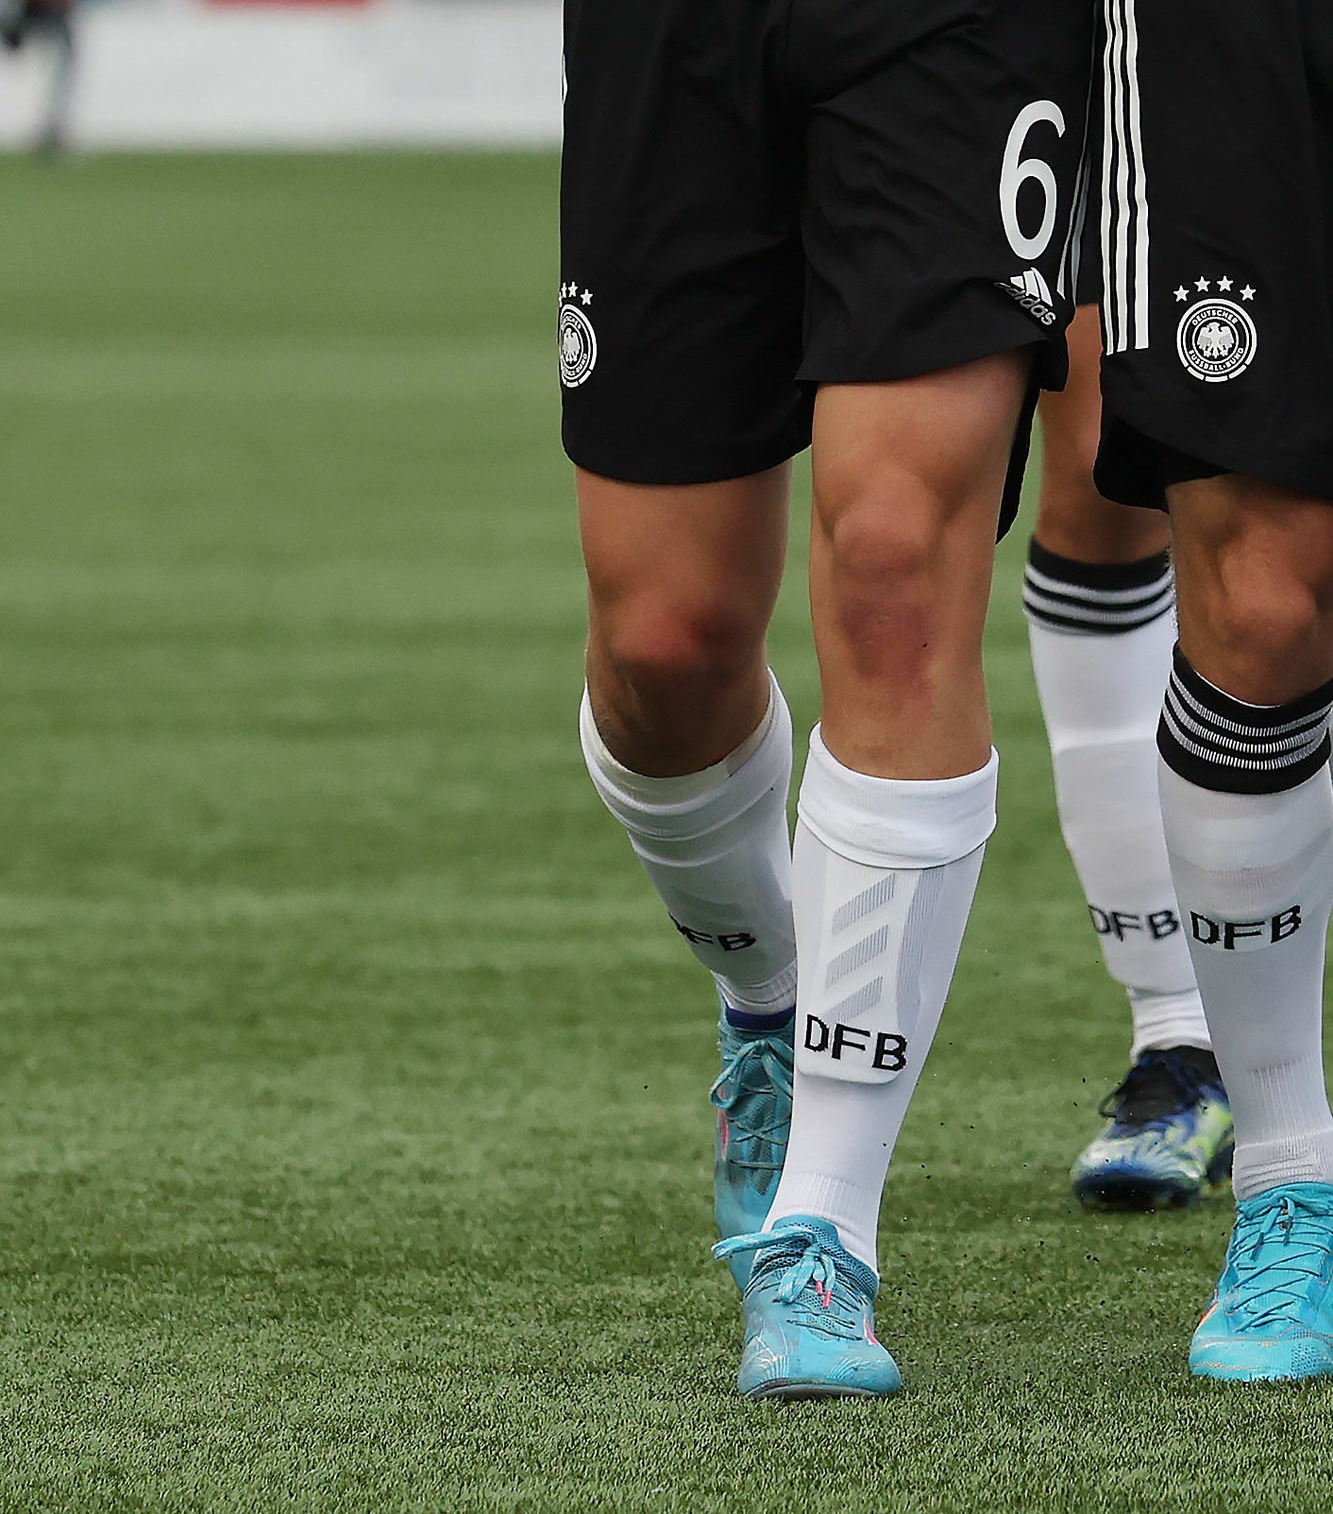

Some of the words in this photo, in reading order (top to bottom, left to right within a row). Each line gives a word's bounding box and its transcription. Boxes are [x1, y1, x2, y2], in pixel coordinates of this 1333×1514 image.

[1000, 99, 1065, 260] 6
[668, 911, 757, 952] FB
[1088, 904, 1178, 943] DFB
[1189, 904, 1302, 950] DFB
[804, 1013, 908, 1072] DFB
